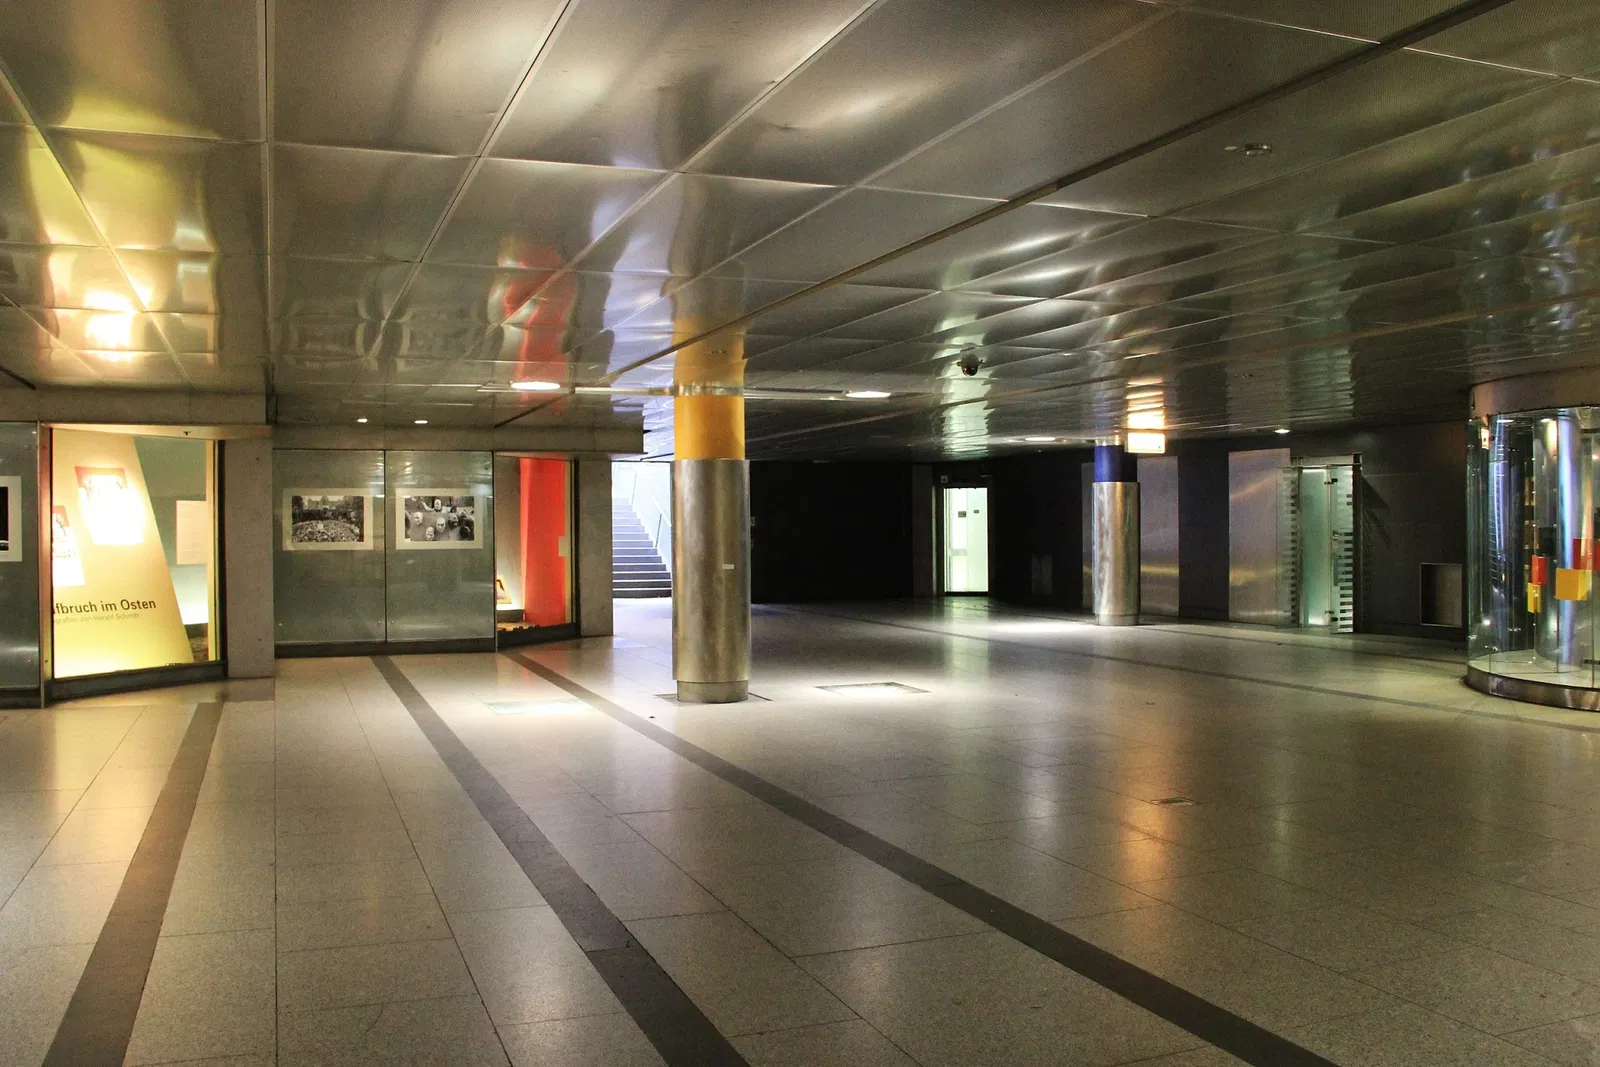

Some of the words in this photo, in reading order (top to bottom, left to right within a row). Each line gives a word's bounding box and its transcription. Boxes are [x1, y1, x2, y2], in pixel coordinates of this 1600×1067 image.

[55, 601, 98, 614] fbruch
[100, 600, 118, 612] im
[120, 598, 157, 611] Osten
